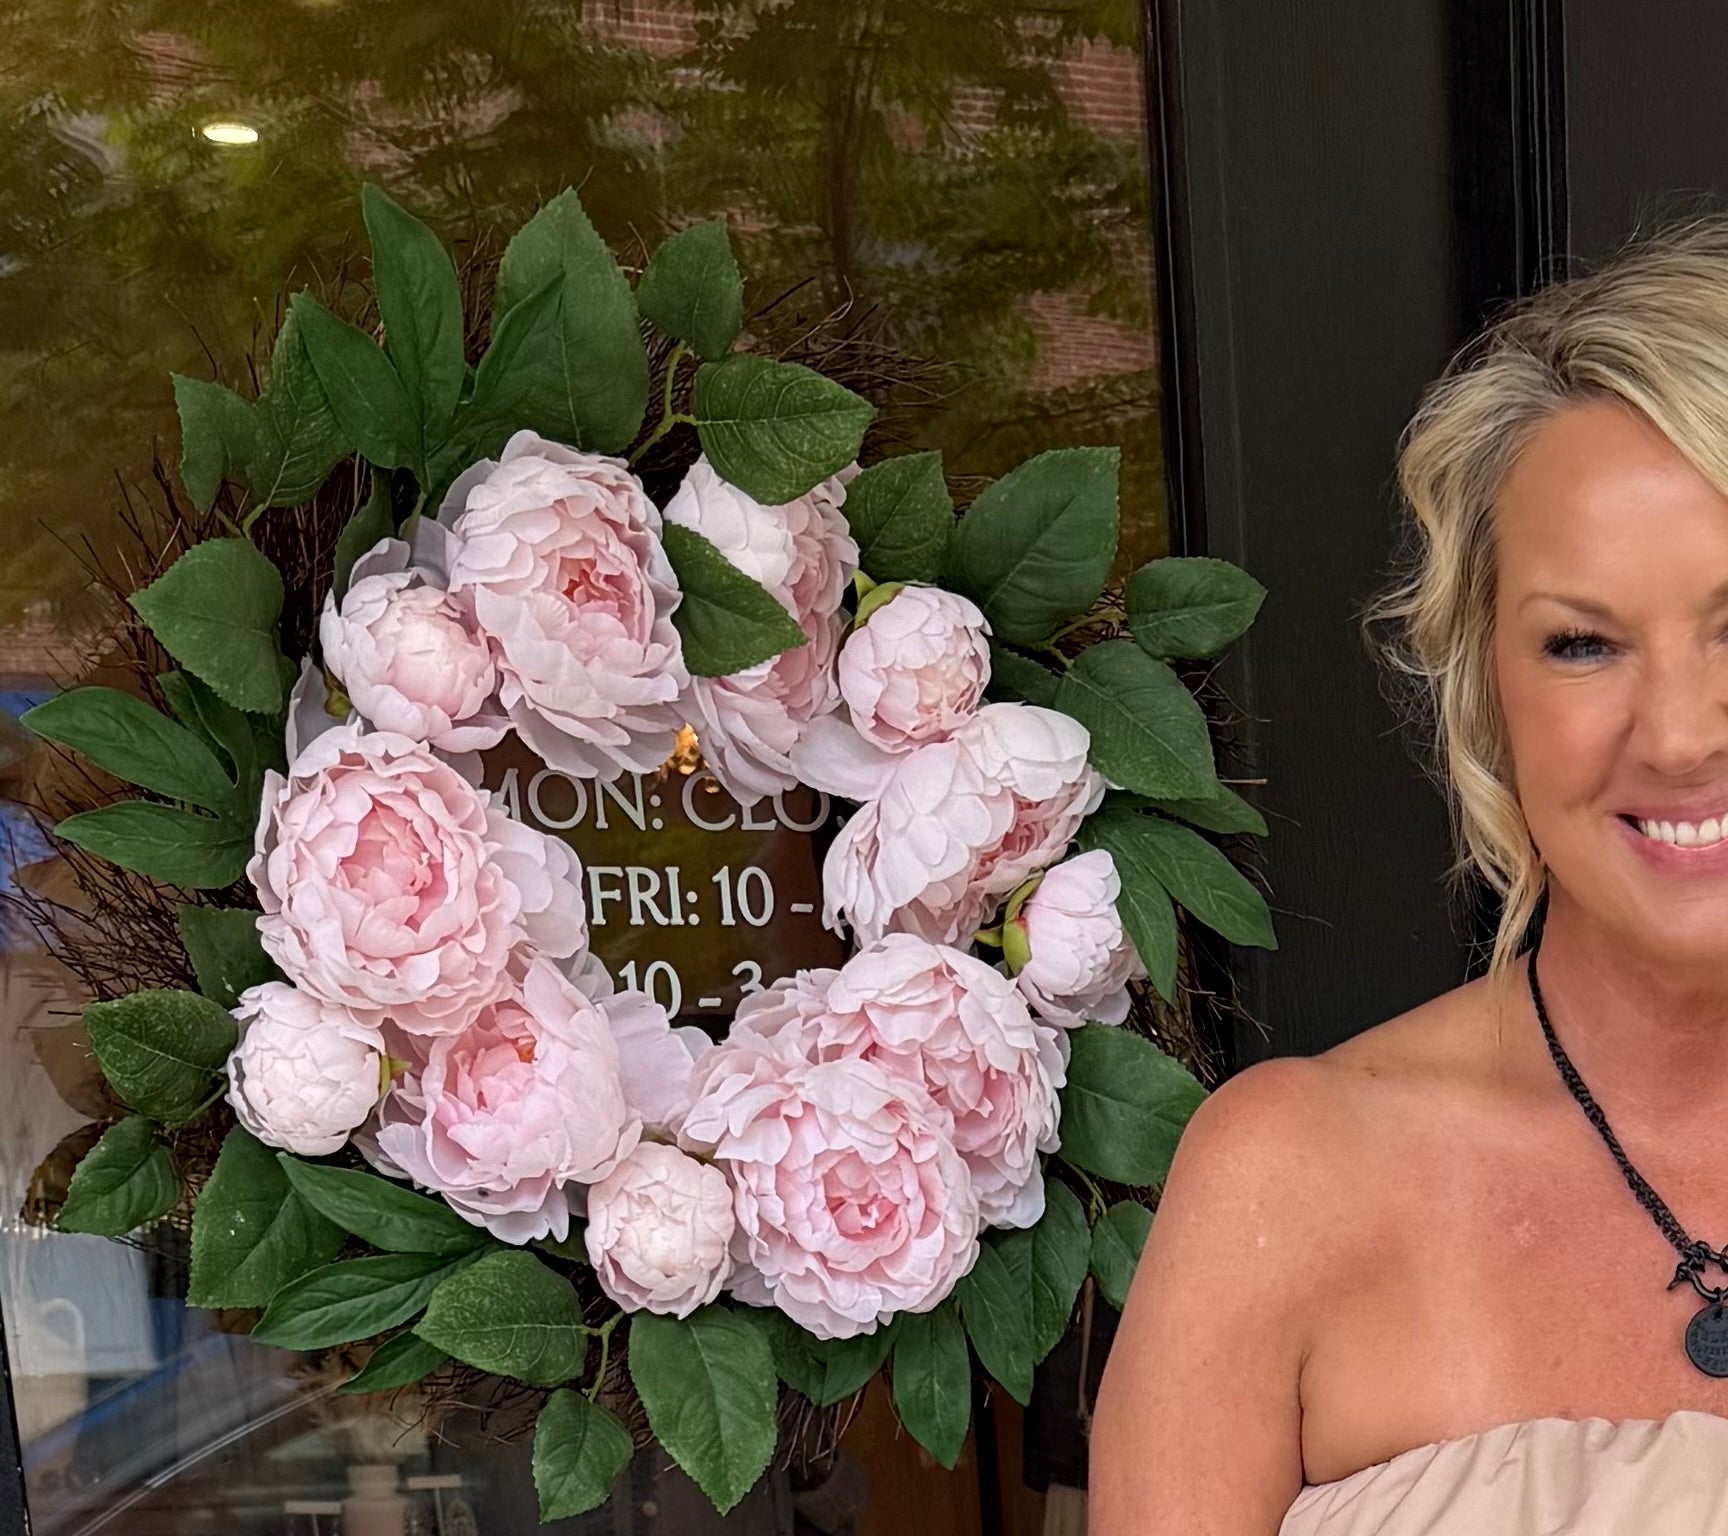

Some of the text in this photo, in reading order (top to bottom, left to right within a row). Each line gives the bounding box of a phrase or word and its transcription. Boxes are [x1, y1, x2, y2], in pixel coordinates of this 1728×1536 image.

[683, 769, 846, 833] CLO
[586, 866, 701, 926] FRI:
[712, 866, 775, 926] 10
